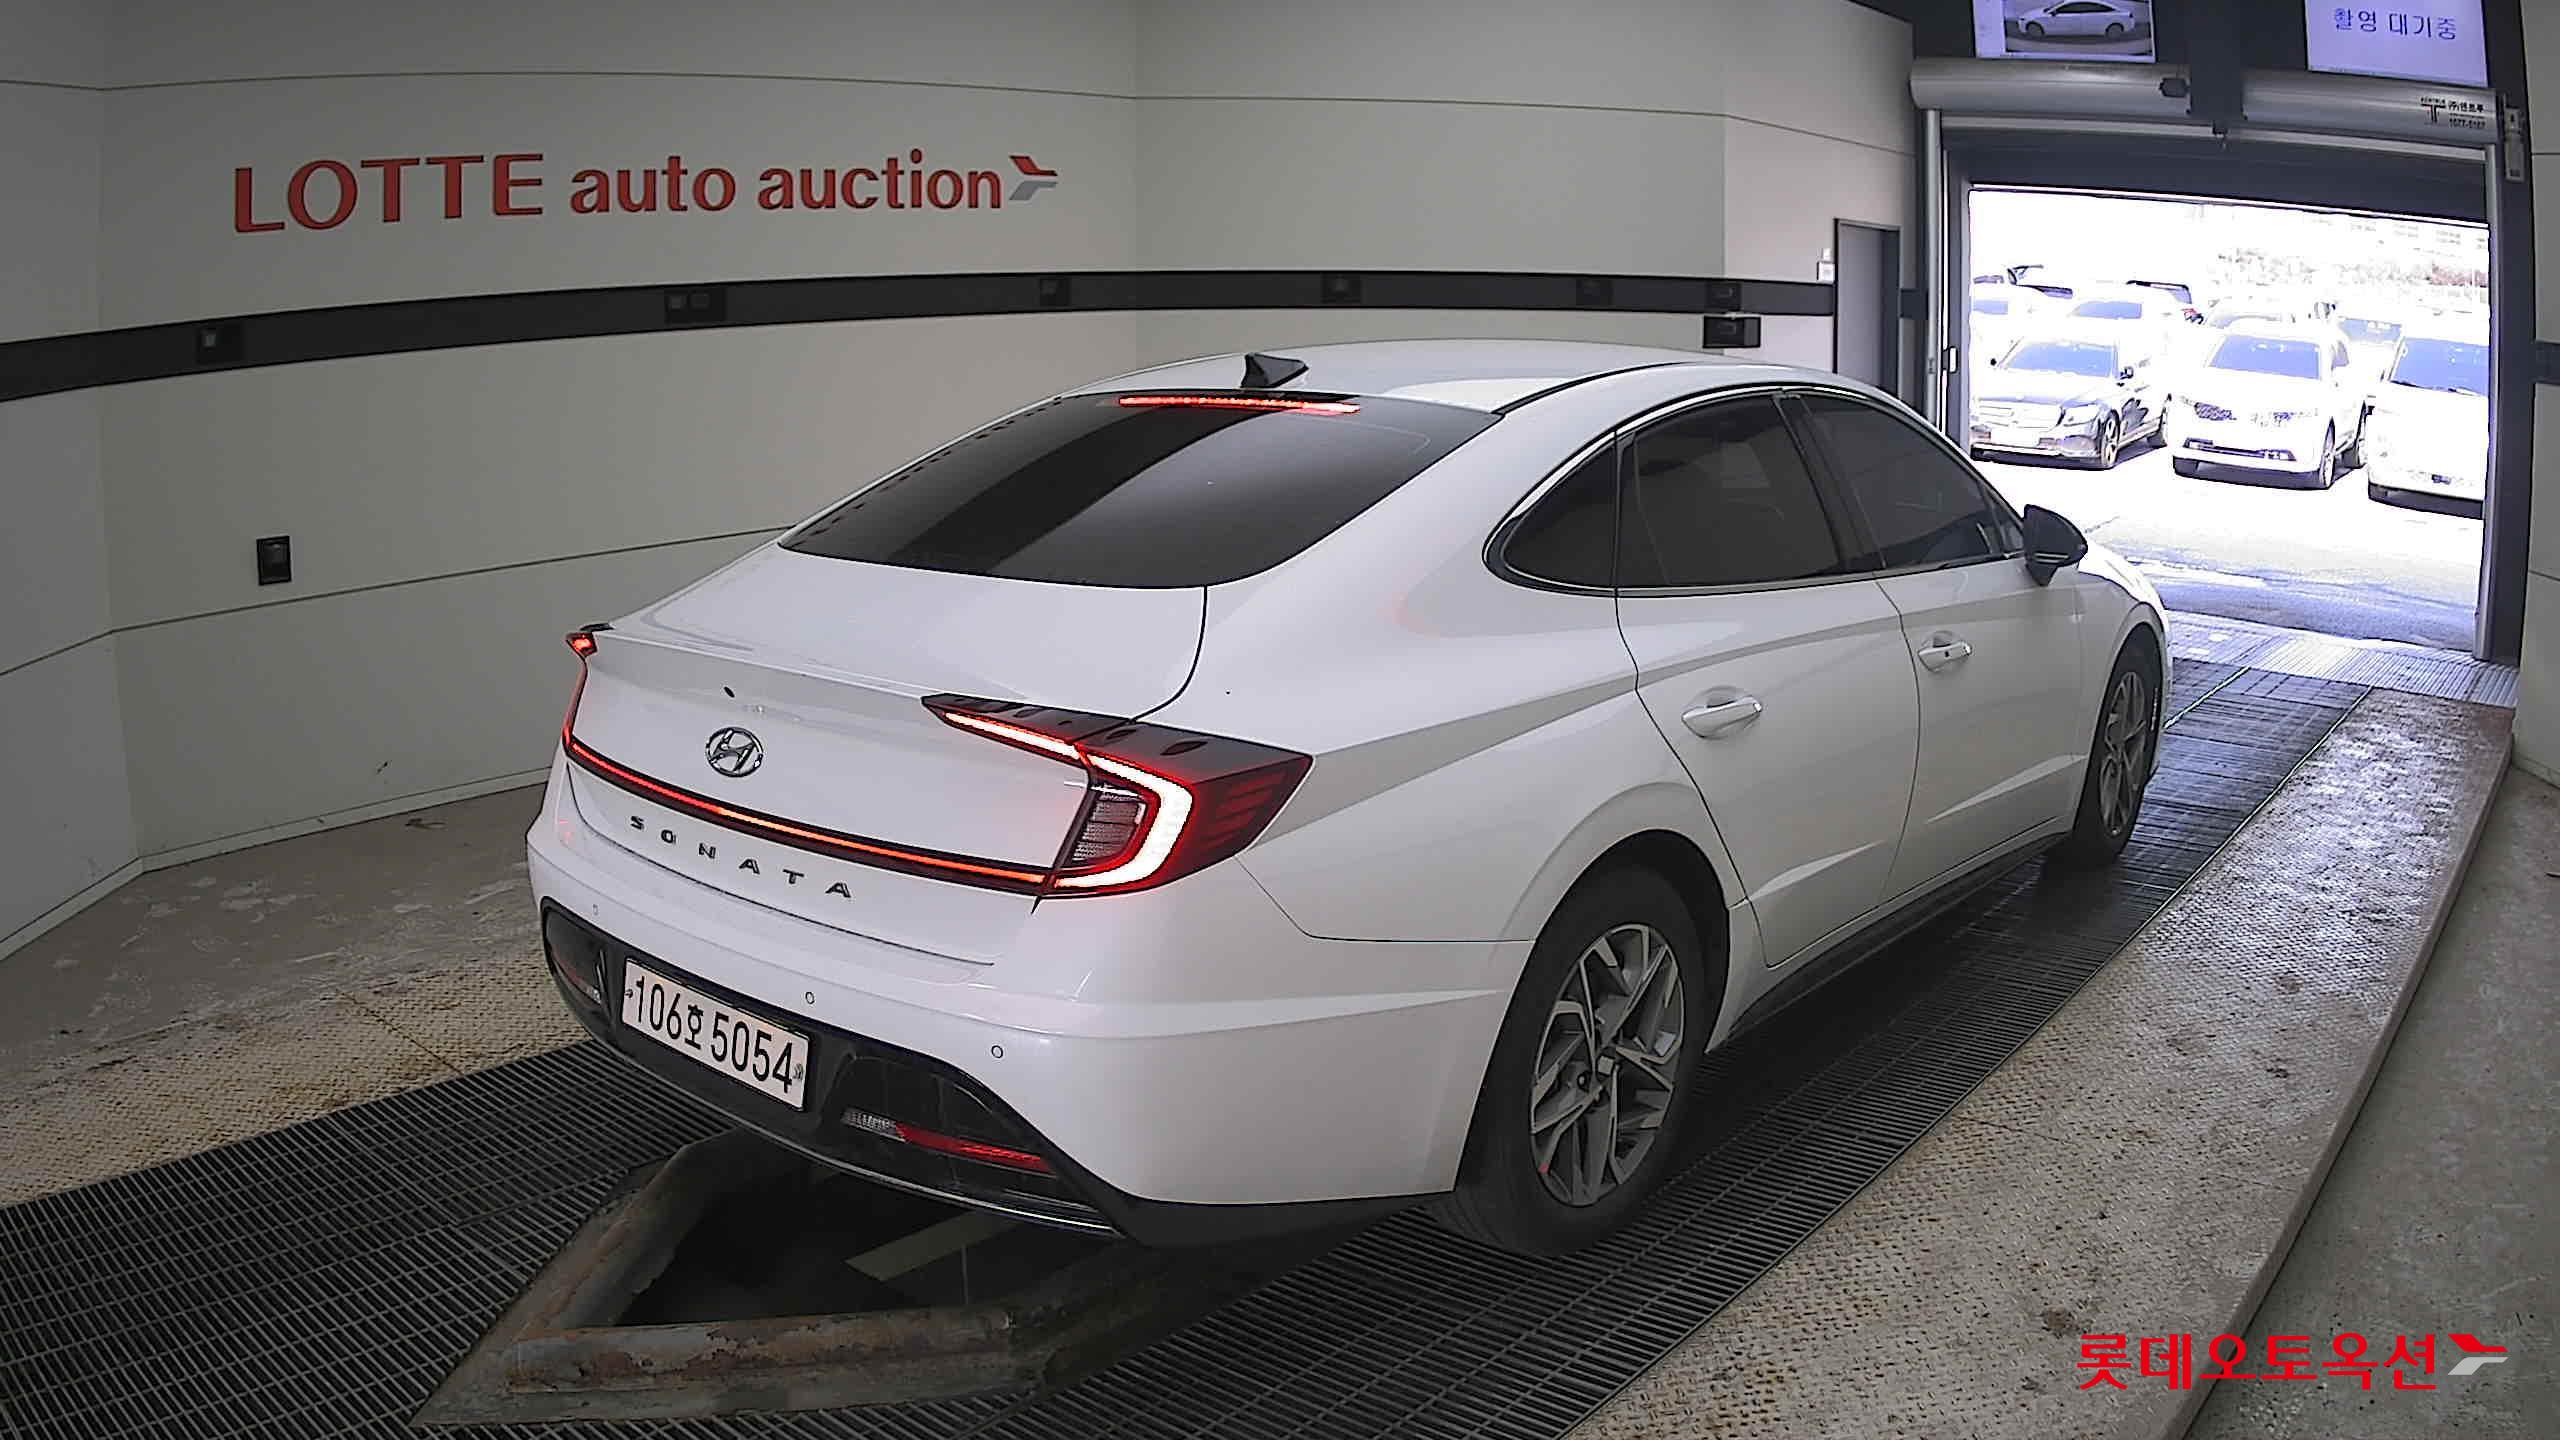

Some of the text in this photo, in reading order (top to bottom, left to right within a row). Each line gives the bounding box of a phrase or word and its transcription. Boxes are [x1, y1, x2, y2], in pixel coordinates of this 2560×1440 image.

[2388, 13, 2457, 40] 대기중
[234, 148, 1002, 233] LOTTE auto auction
[630, 815, 852, 899] SONATA
[635, 975, 793, 1094] 106호 5054
